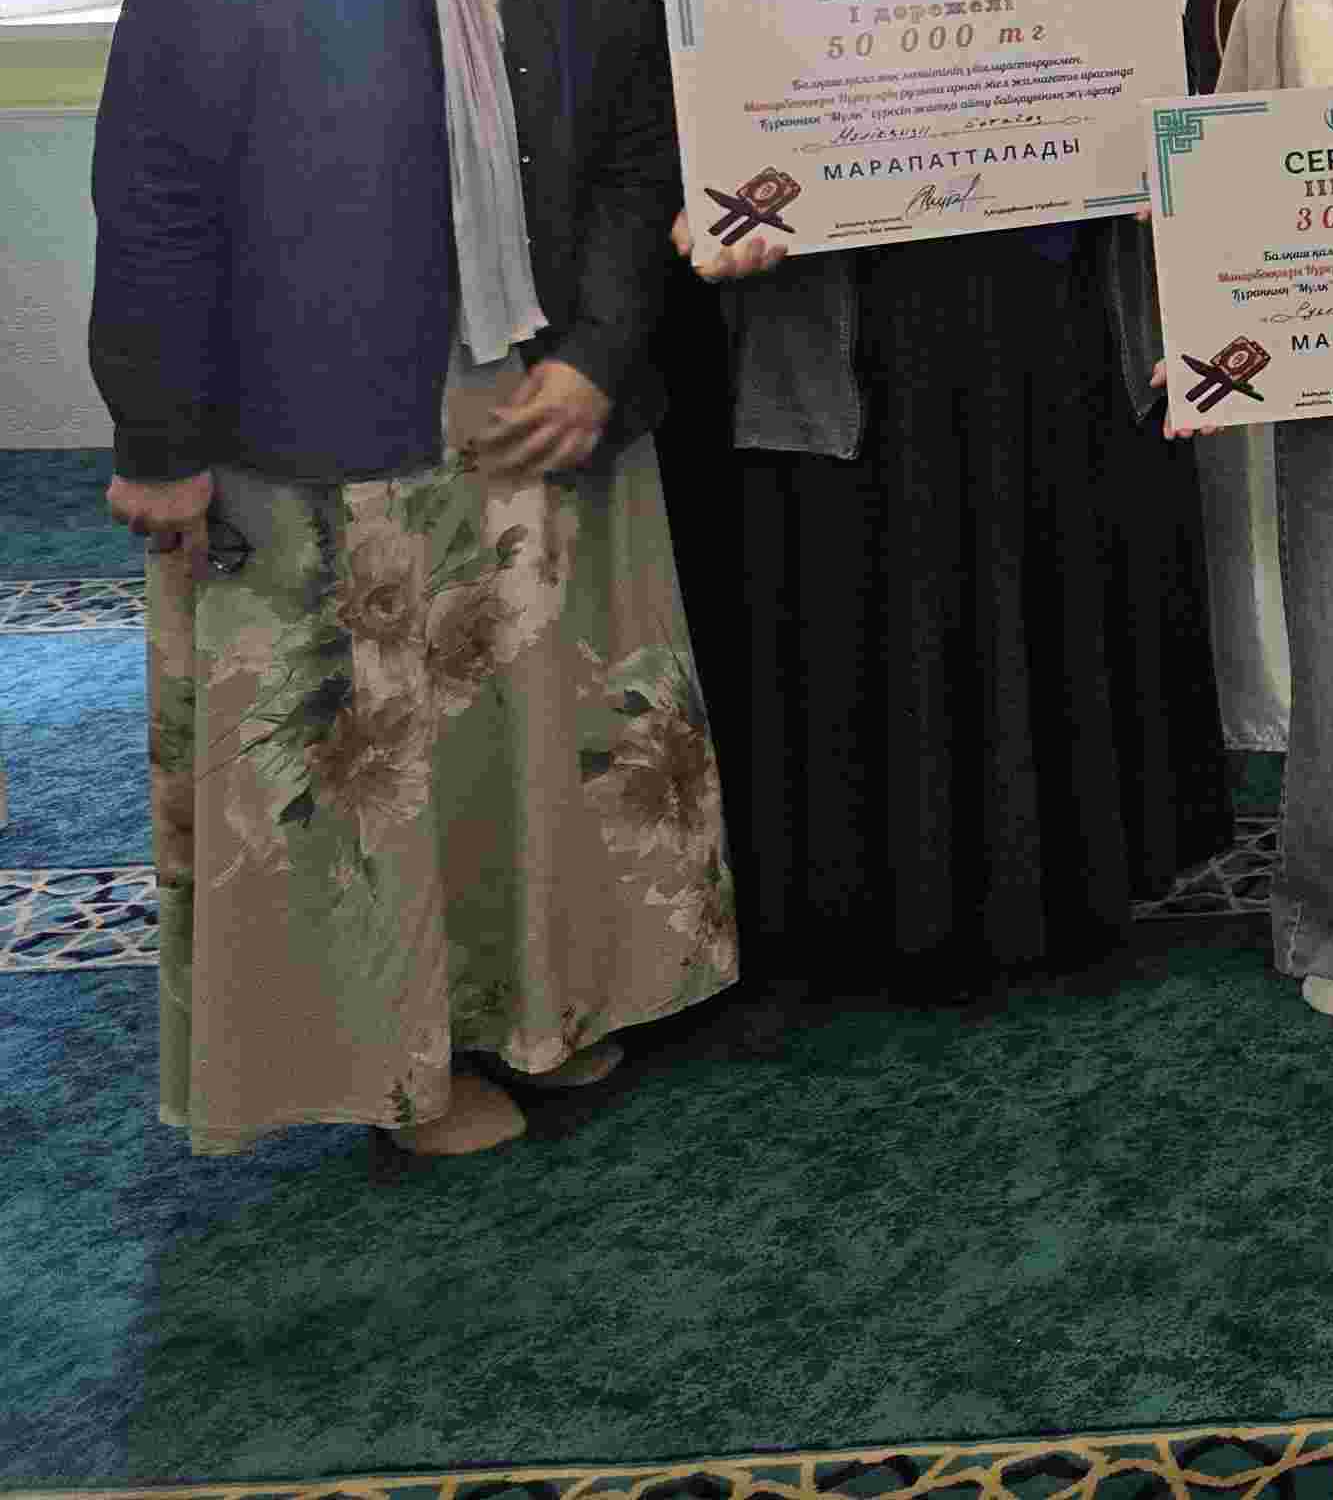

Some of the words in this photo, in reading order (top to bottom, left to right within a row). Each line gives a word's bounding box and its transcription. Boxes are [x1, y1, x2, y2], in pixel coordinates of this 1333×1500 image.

[827, 35, 876, 60] 50
[900, 25, 976, 53] 000
[998, 23, 1048, 44] тг
[823, 138, 1081, 182] МАРАПАТТАЛАДЫ
